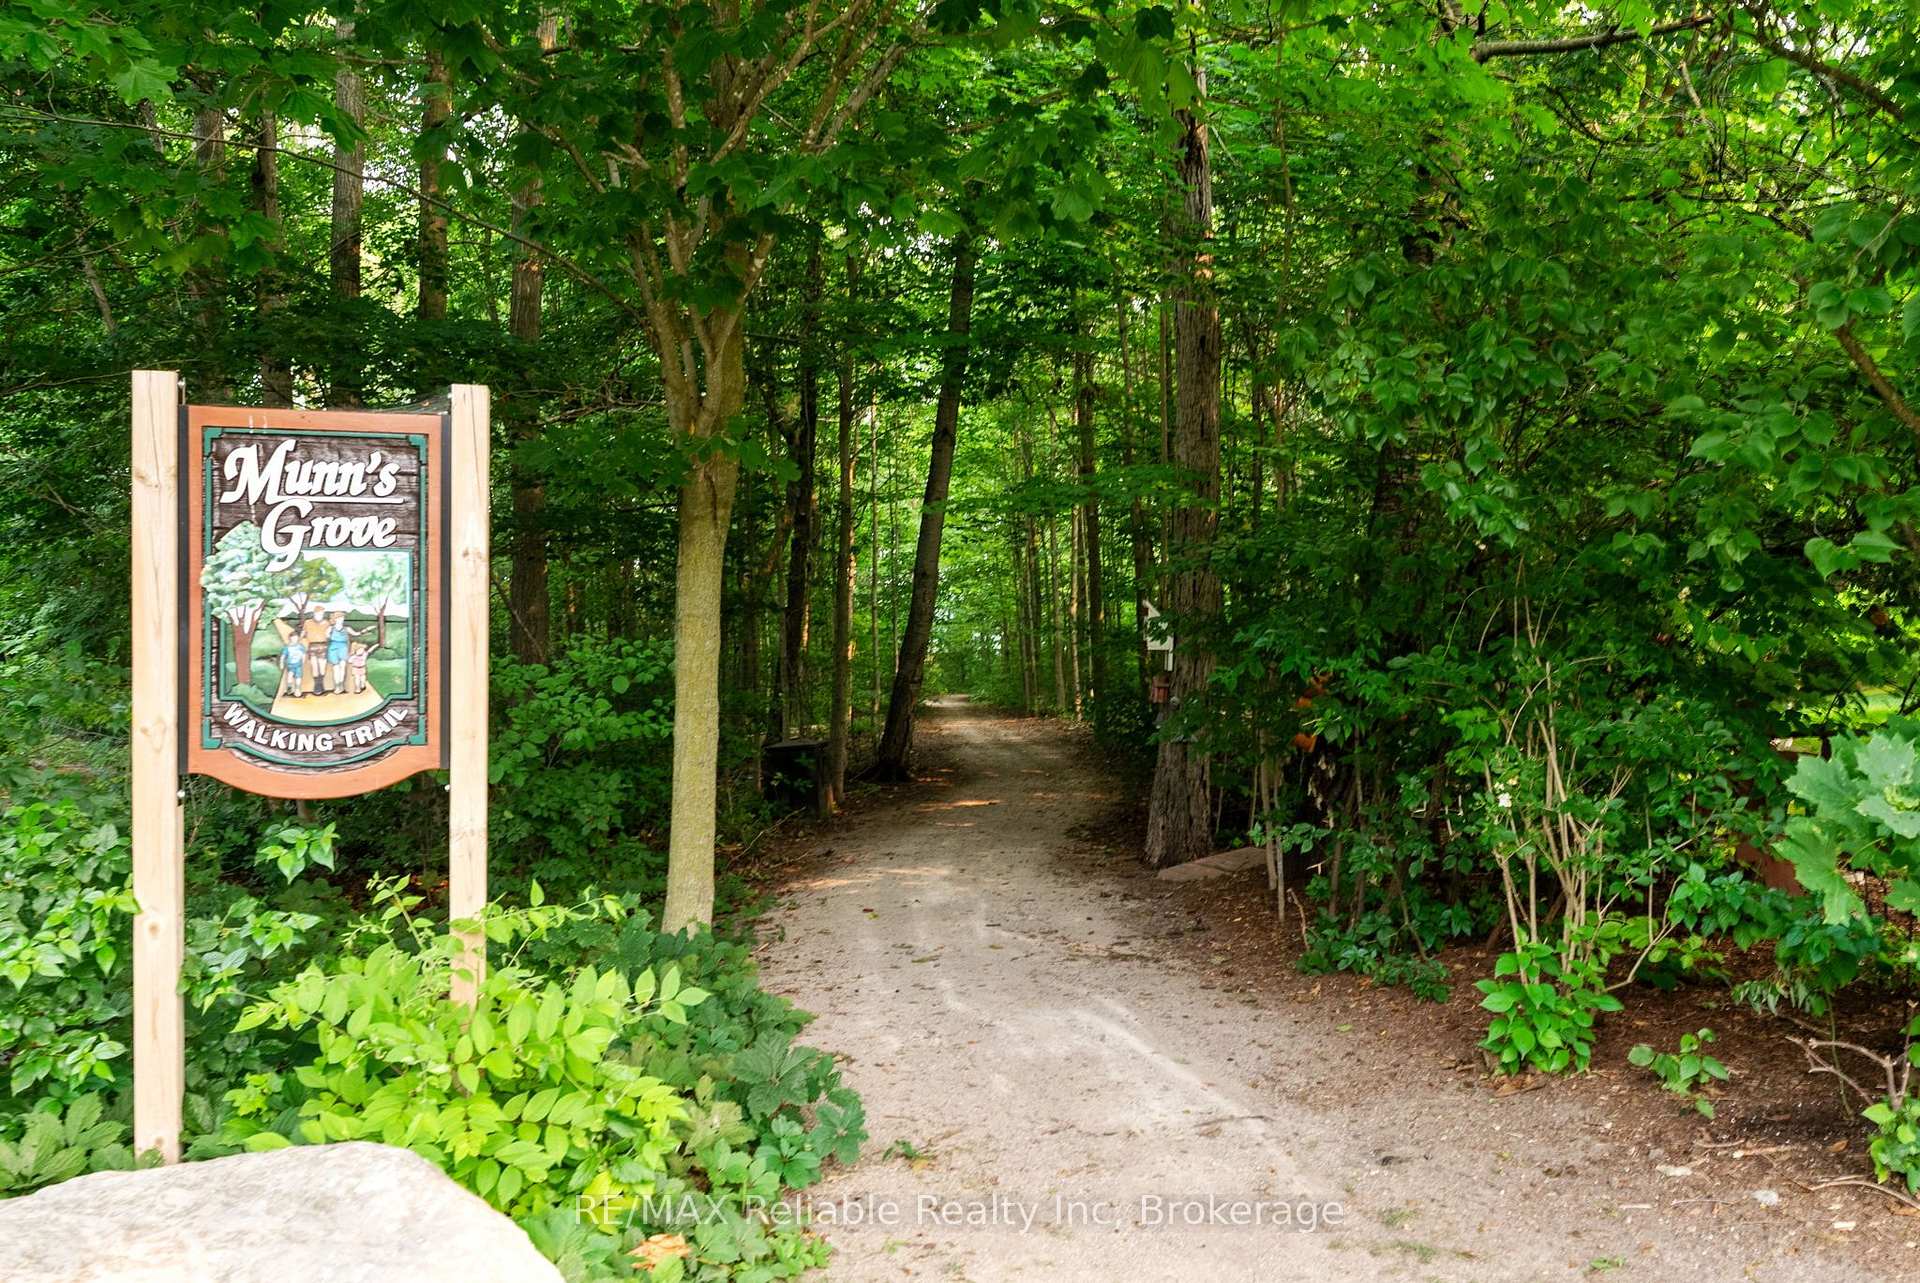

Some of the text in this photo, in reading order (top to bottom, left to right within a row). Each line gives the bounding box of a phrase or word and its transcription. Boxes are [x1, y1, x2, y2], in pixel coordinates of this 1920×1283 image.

[220, 439, 403, 505] Munn's
[261, 498, 398, 573] Grove
[223, 702, 408, 752] WALKING TRAIL
